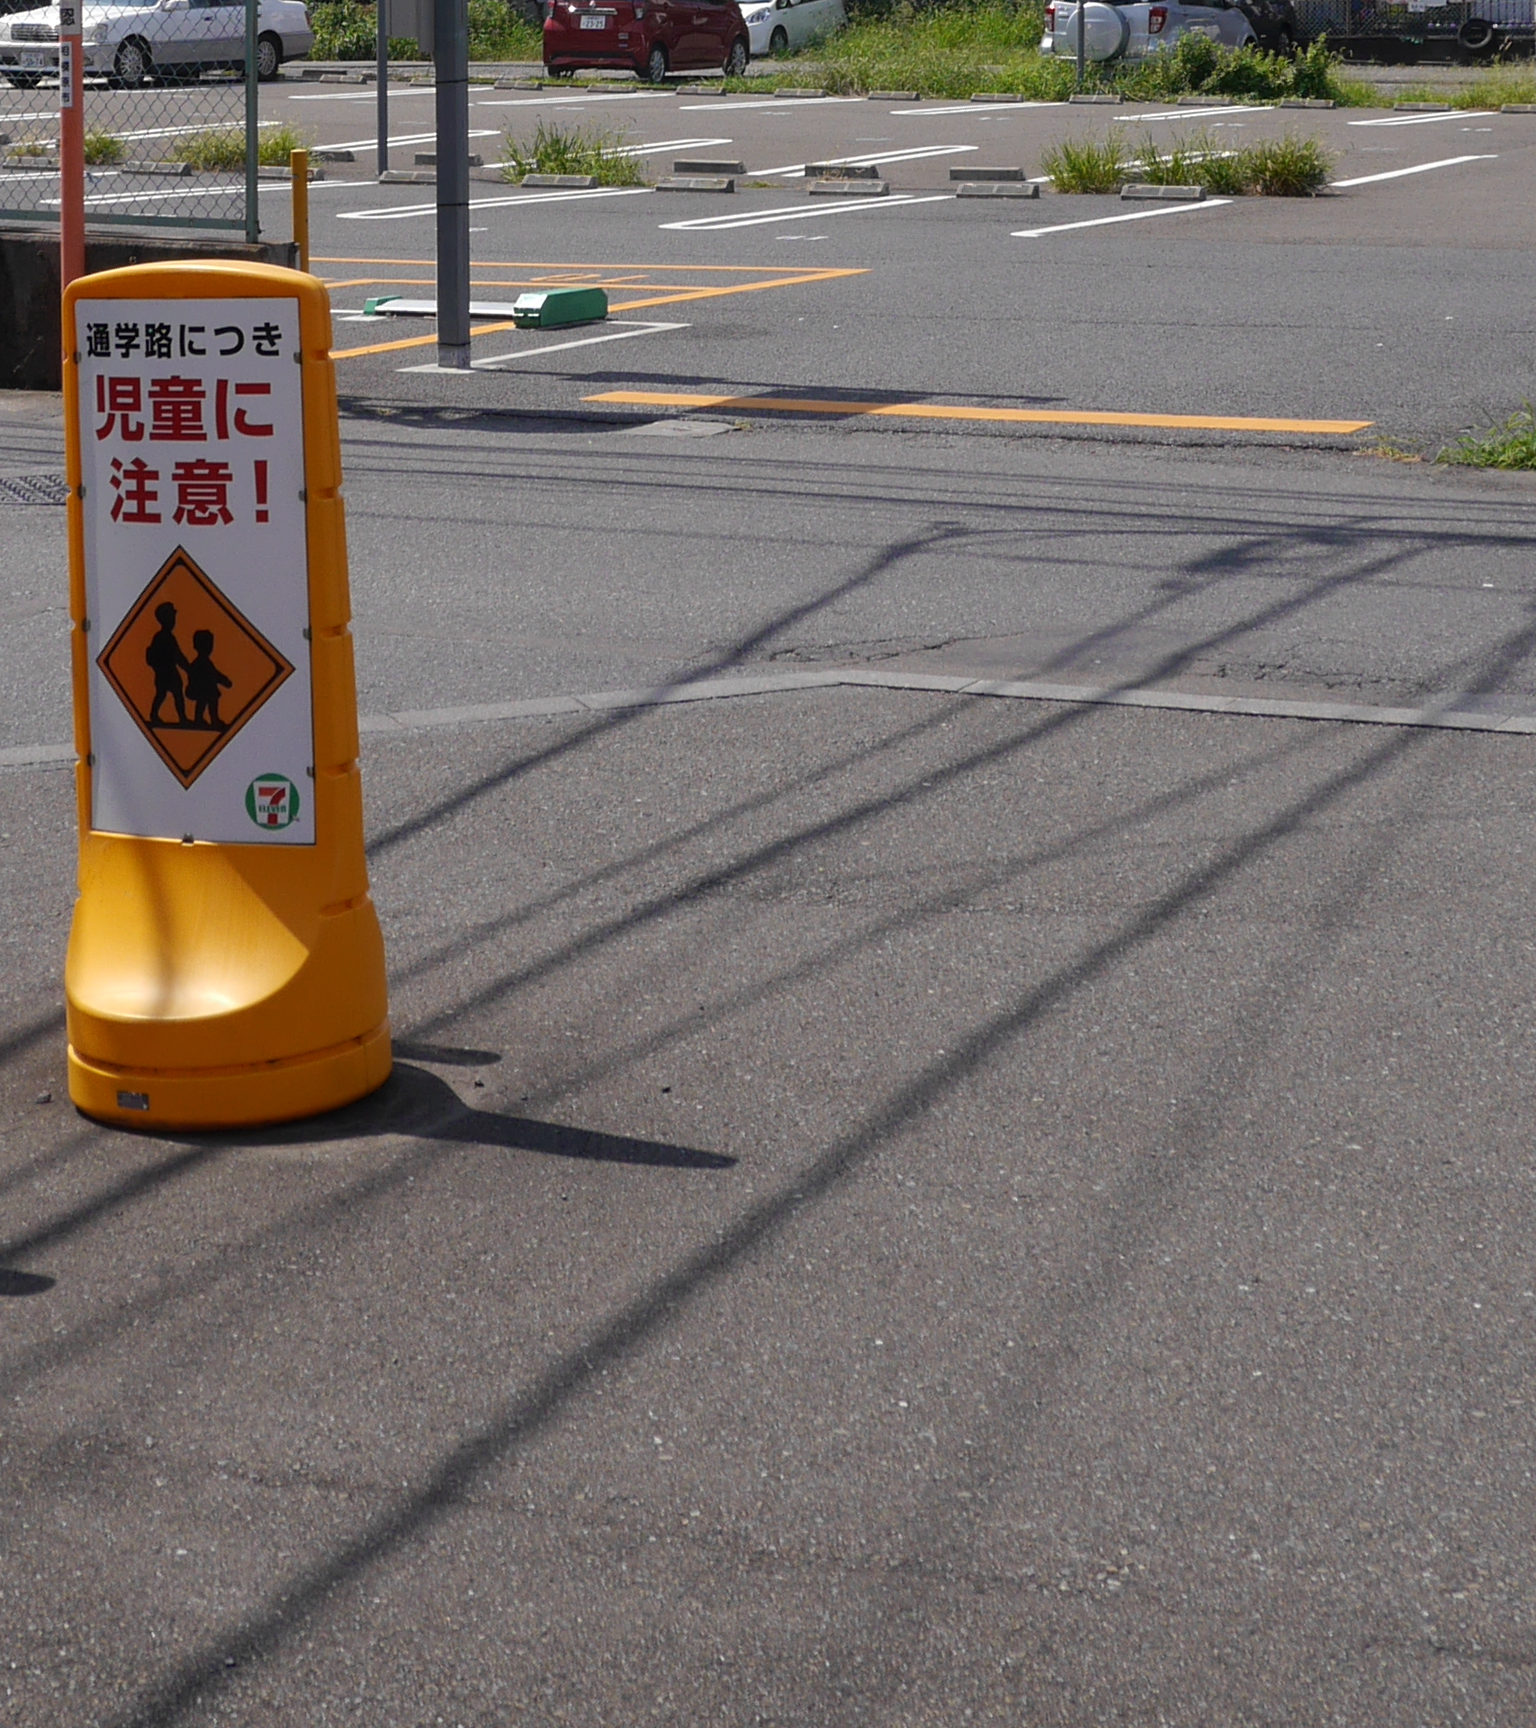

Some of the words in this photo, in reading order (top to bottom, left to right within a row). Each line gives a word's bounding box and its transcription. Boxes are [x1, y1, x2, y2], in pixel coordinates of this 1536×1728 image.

[86, 322, 282, 359] 通学路につき
[95, 374, 274, 442] 児童に
[109, 456, 270, 526] 注意!
